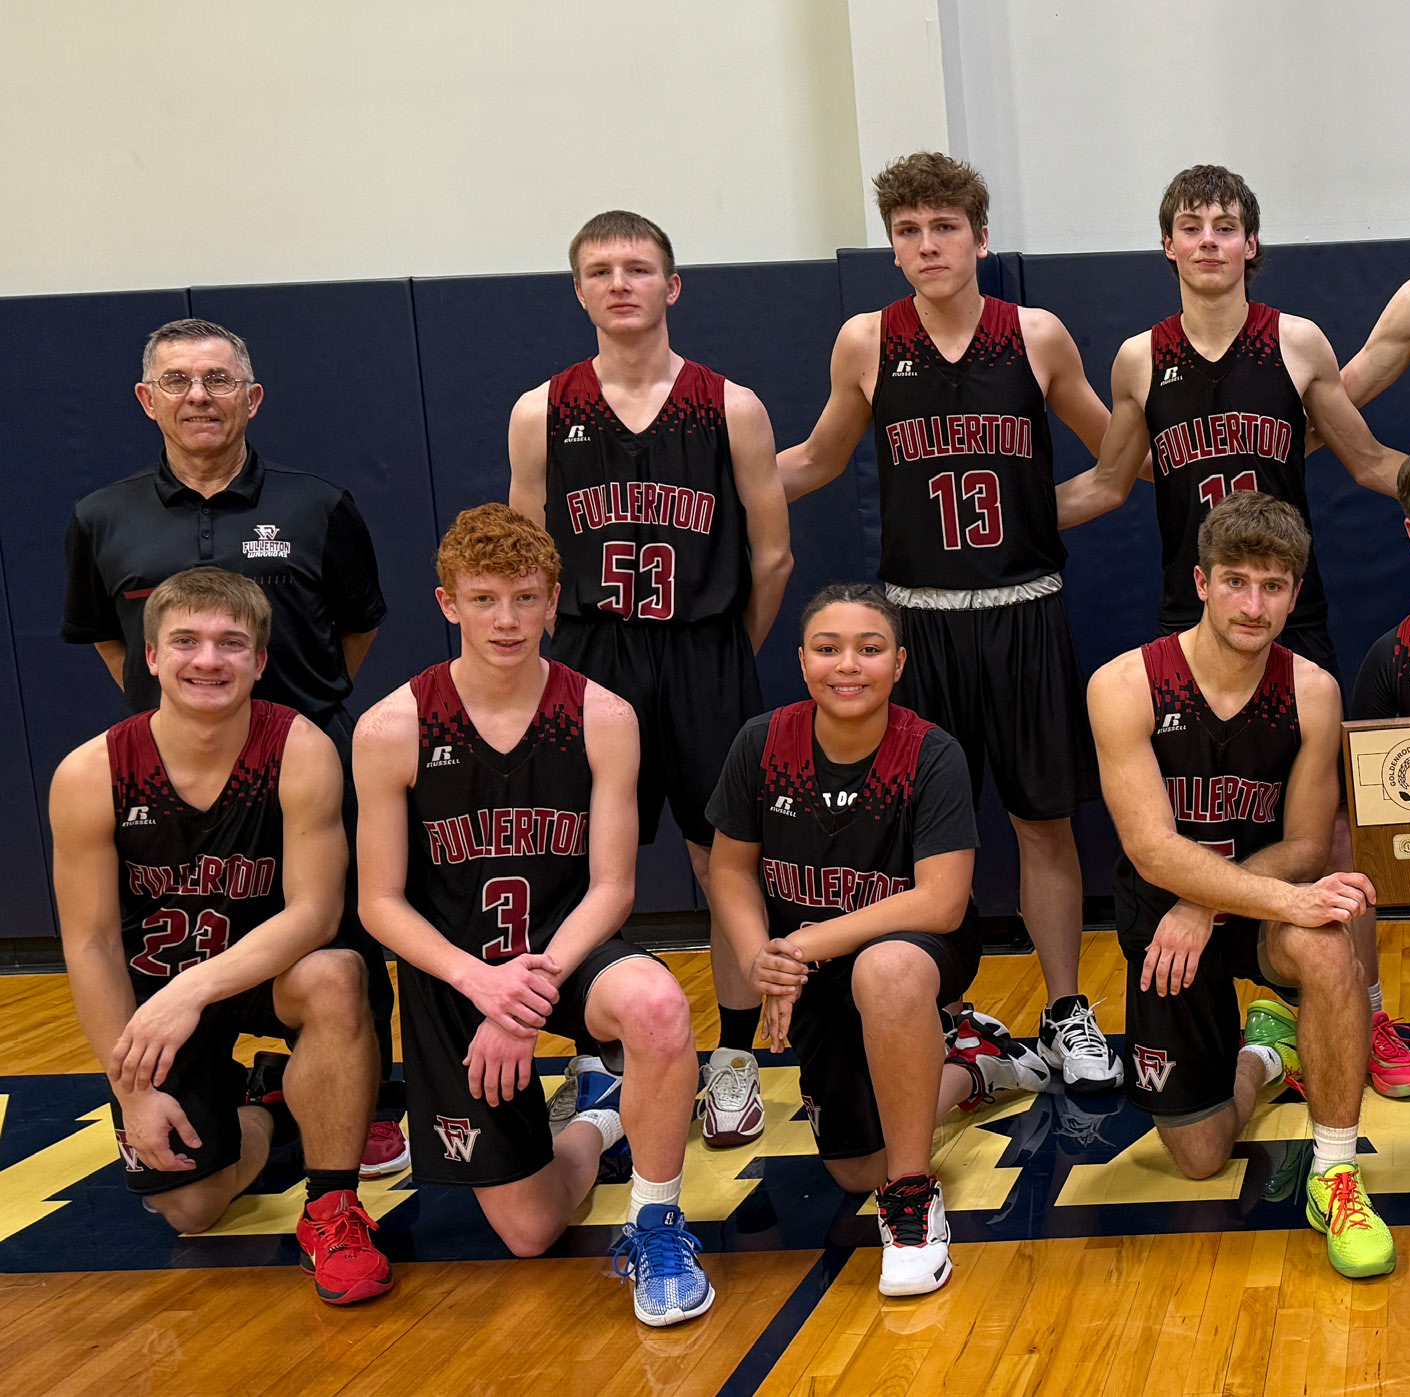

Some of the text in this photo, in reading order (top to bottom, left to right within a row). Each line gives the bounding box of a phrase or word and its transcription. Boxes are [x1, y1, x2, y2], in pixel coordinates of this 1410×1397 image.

[885, 414, 1033, 465] FULLERTON
[1154, 411, 1292, 477] FULLERTON
[566, 482, 716, 534] FULLERTON
[929, 470, 1003, 550] 13
[242, 540, 291, 554] FULLERTON
[599, 541, 675, 620] 53
[1156, 725, 1187, 735] RUSSELL
[426, 758, 460, 768] RUSSELL
[121, 819, 157, 827] RUSSELL
[769, 806, 797, 817] RUSSELL
[1162, 775, 1282, 823] ULLERTON
[129, 907, 231, 977] 23
[482, 876, 531, 960] 3
